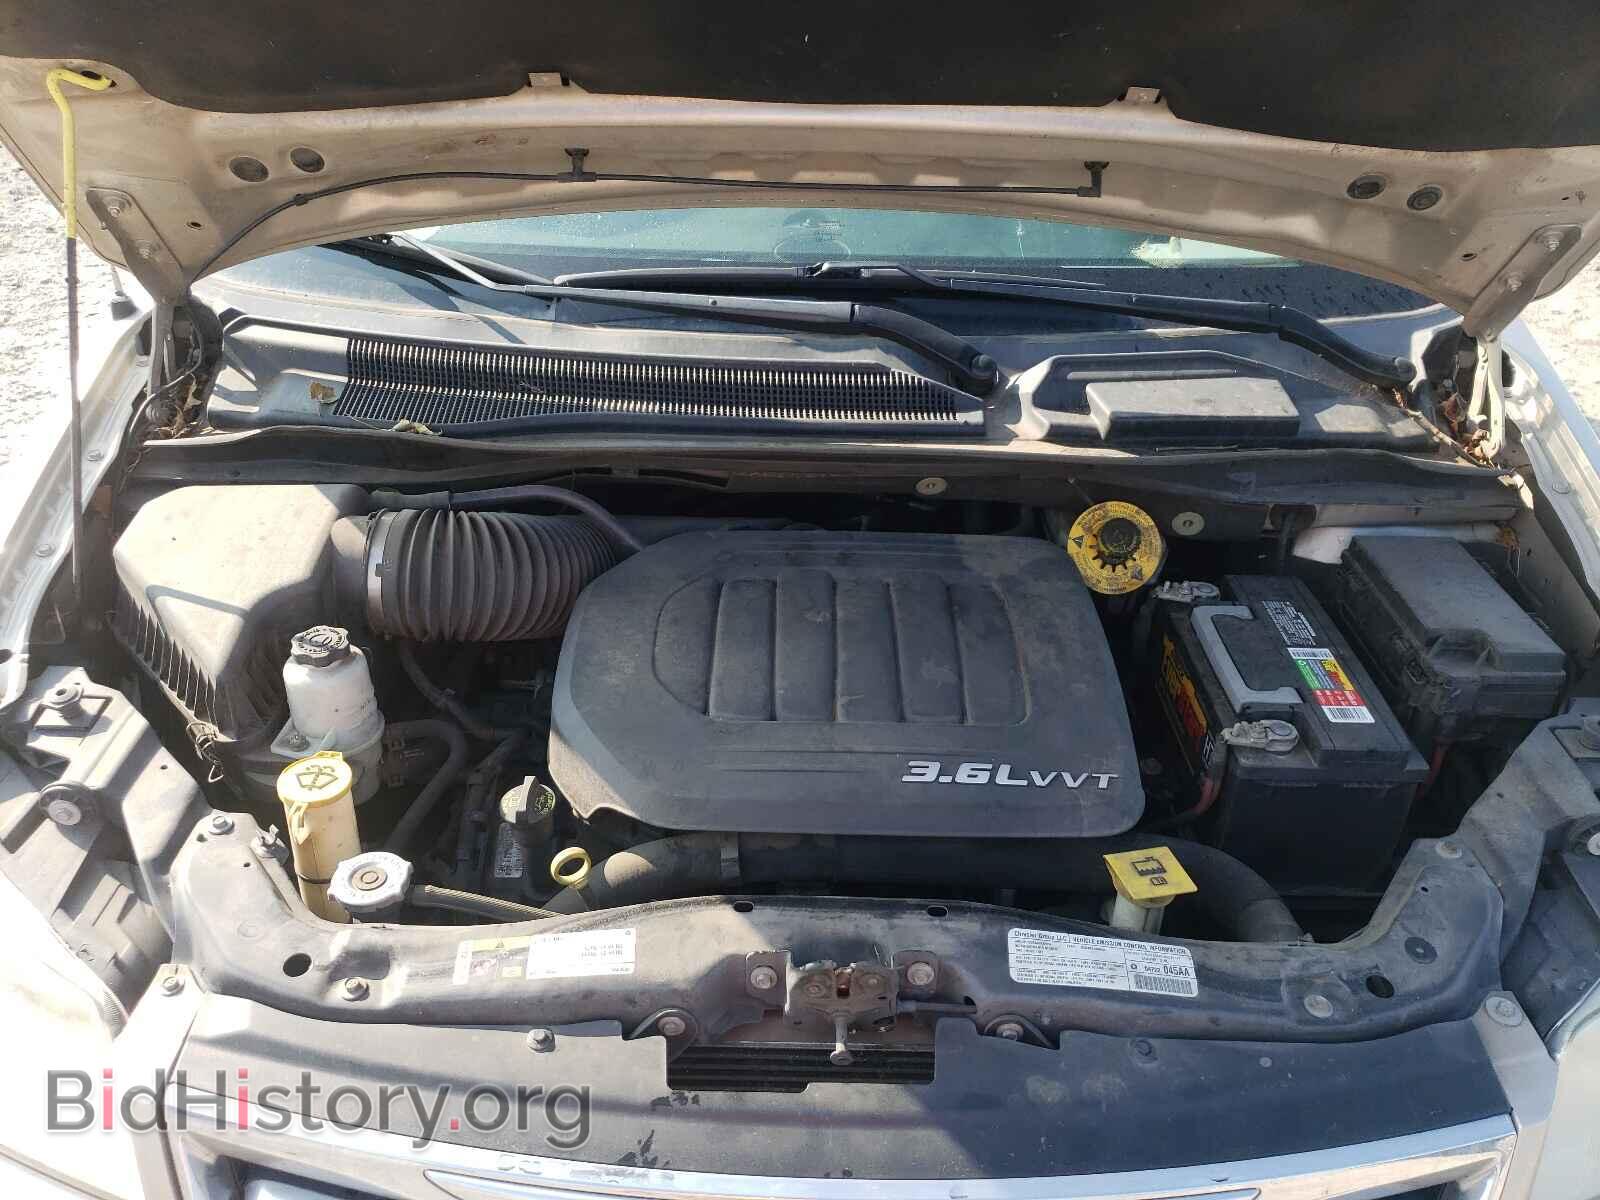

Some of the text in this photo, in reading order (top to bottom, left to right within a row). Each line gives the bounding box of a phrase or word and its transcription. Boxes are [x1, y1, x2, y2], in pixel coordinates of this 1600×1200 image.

[1123, 941, 1147, 950] CONTROL
[1149, 944, 1187, 954] INFORMATION
[1162, 963, 1190, 977] 045AA
